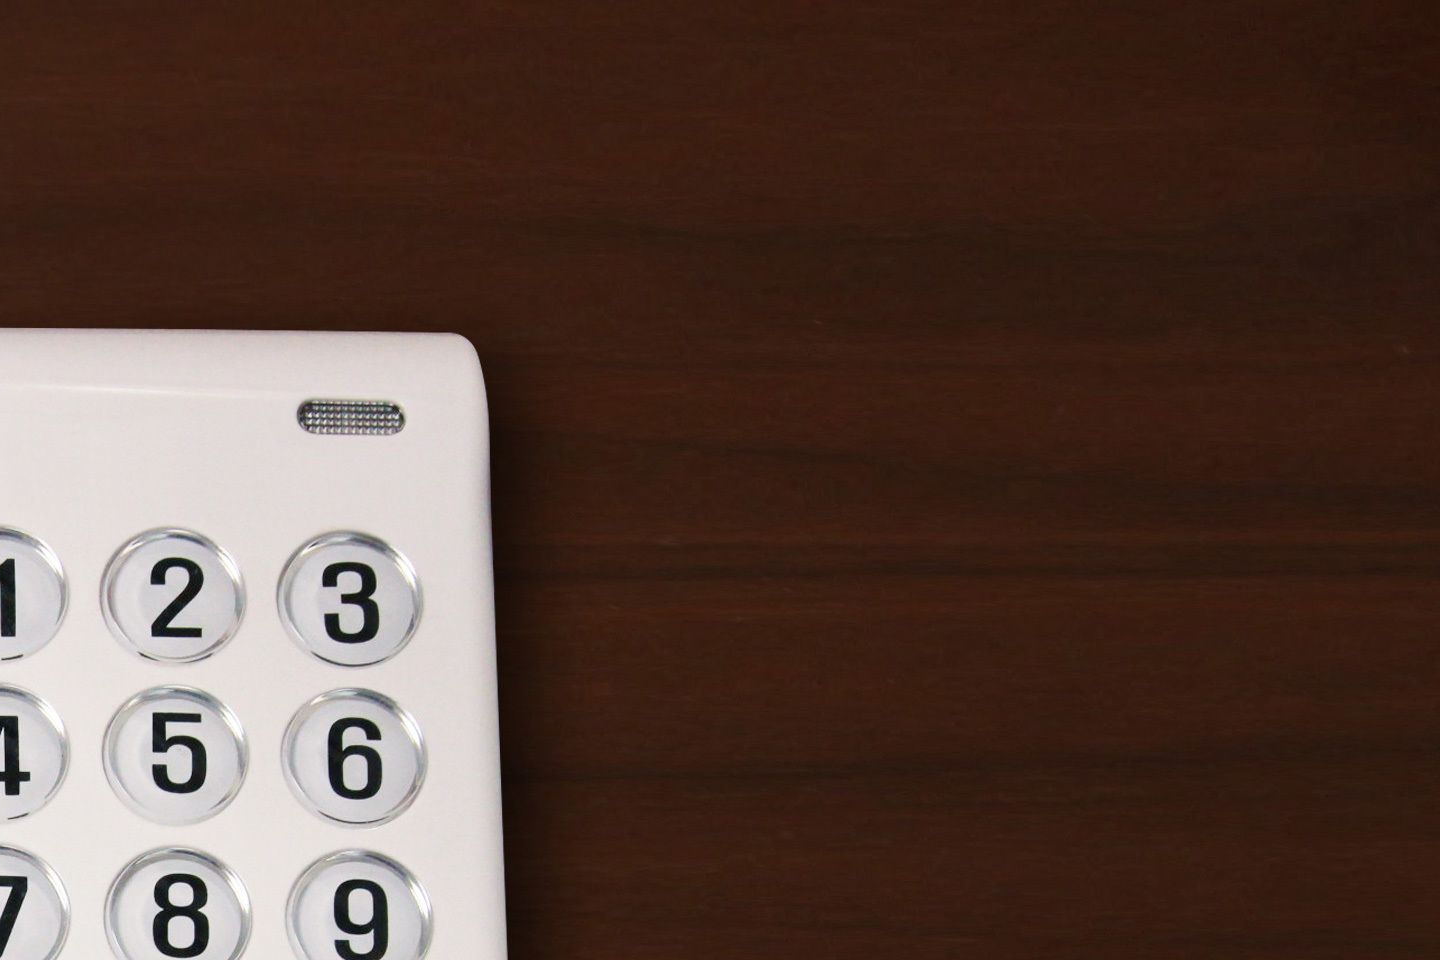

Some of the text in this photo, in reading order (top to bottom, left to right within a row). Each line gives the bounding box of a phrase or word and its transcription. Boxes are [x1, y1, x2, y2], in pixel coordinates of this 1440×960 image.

[151, 558, 204, 637] 2
[322, 562, 379, 643] 3
[152, 713, 206, 793] 5
[328, 718, 382, 799] 6
[153, 874, 209, 958] 8
